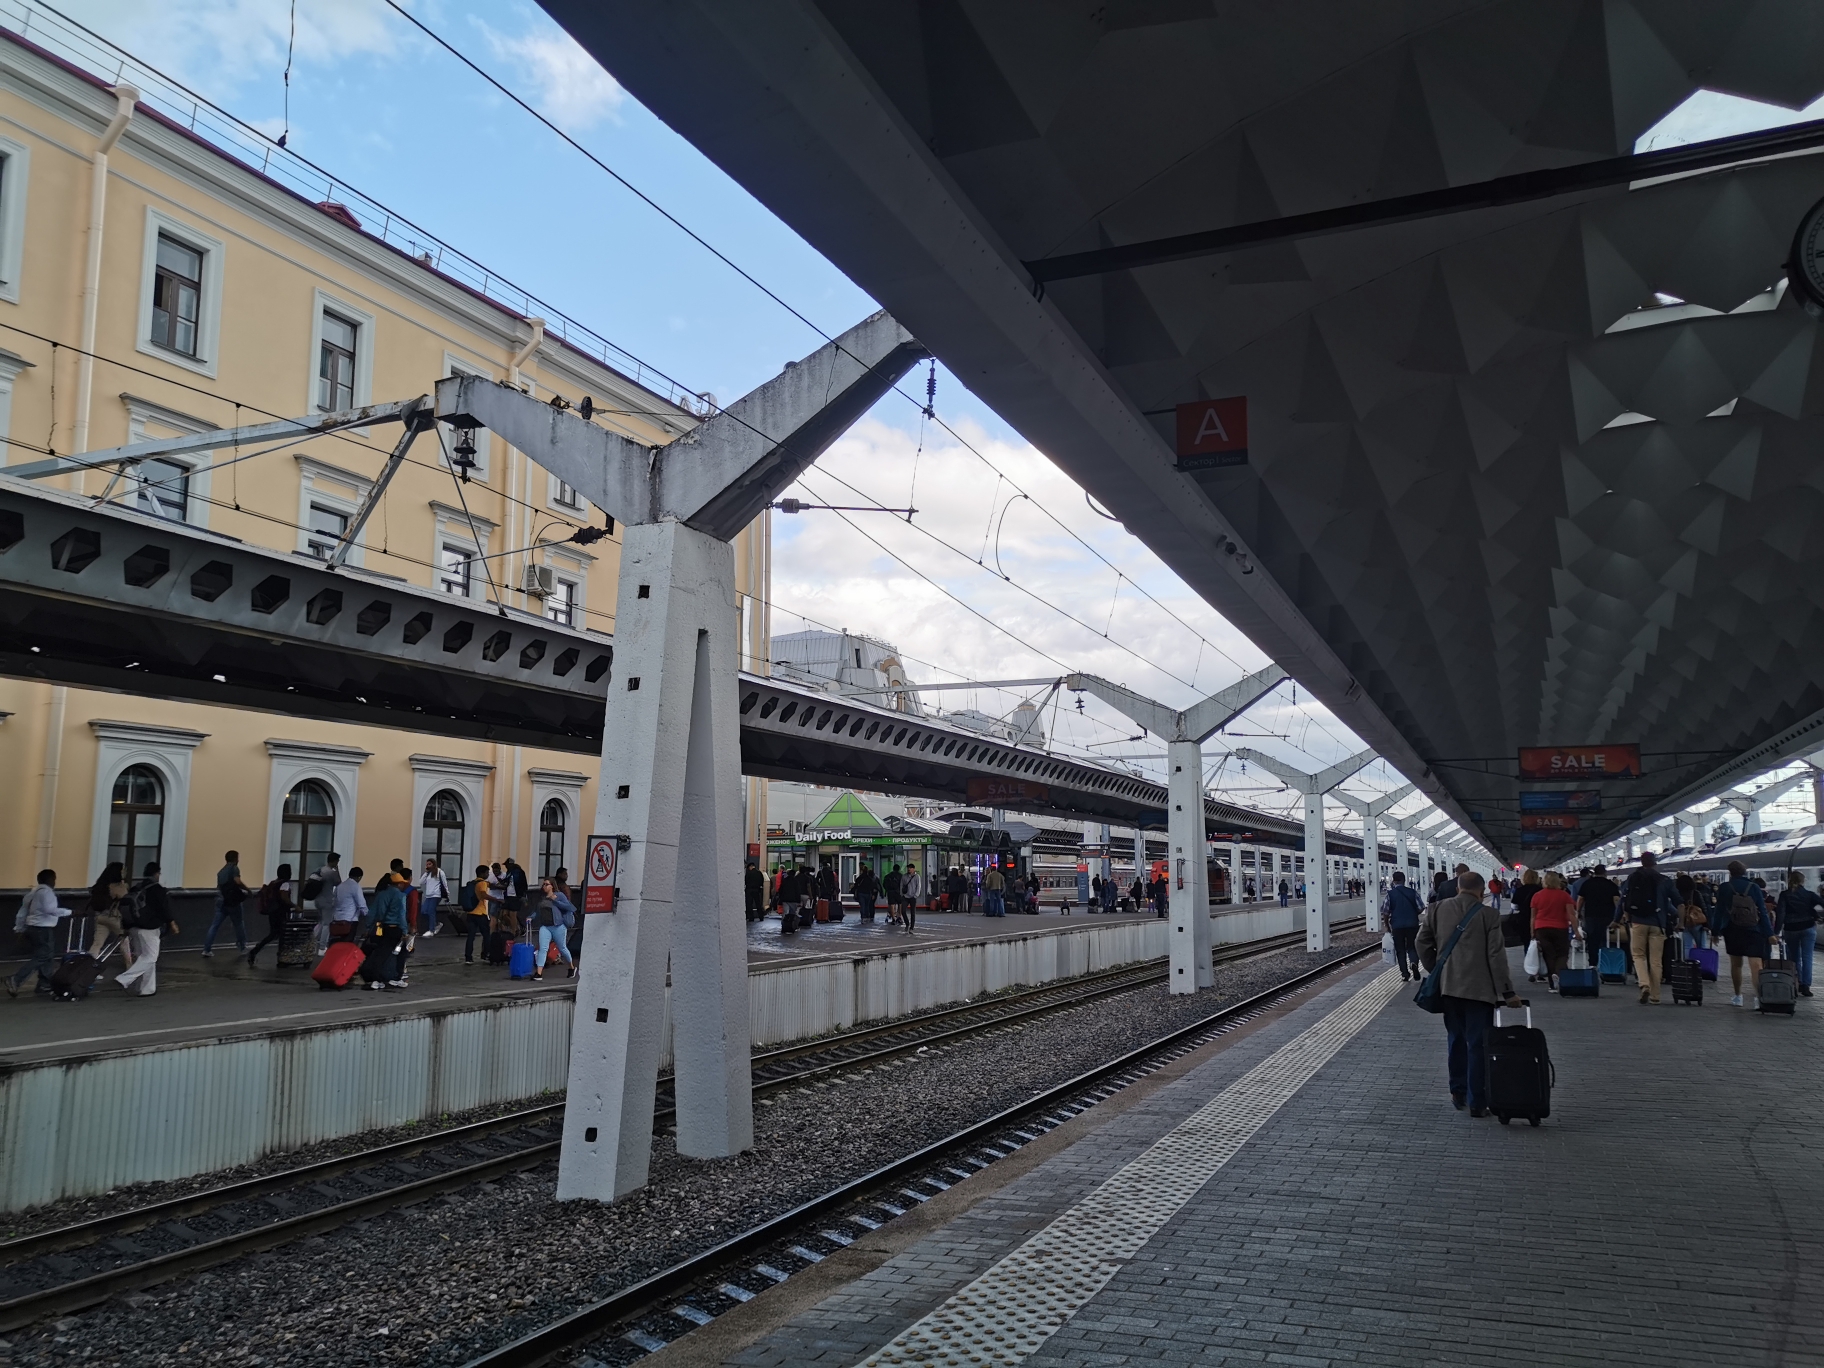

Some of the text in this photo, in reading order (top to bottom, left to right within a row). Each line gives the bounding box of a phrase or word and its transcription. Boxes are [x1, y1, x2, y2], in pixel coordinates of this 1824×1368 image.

[1194, 408, 1230, 445] А
[1183, 458, 1215, 467] Сектор
[1221, 456, 1242, 464] Sector
[1551, 754, 1606, 768] SALE
[988, 783, 1026, 794] SALE
[1536, 818, 1564, 826] SALE
[795, 830, 852, 844] Daily Food
